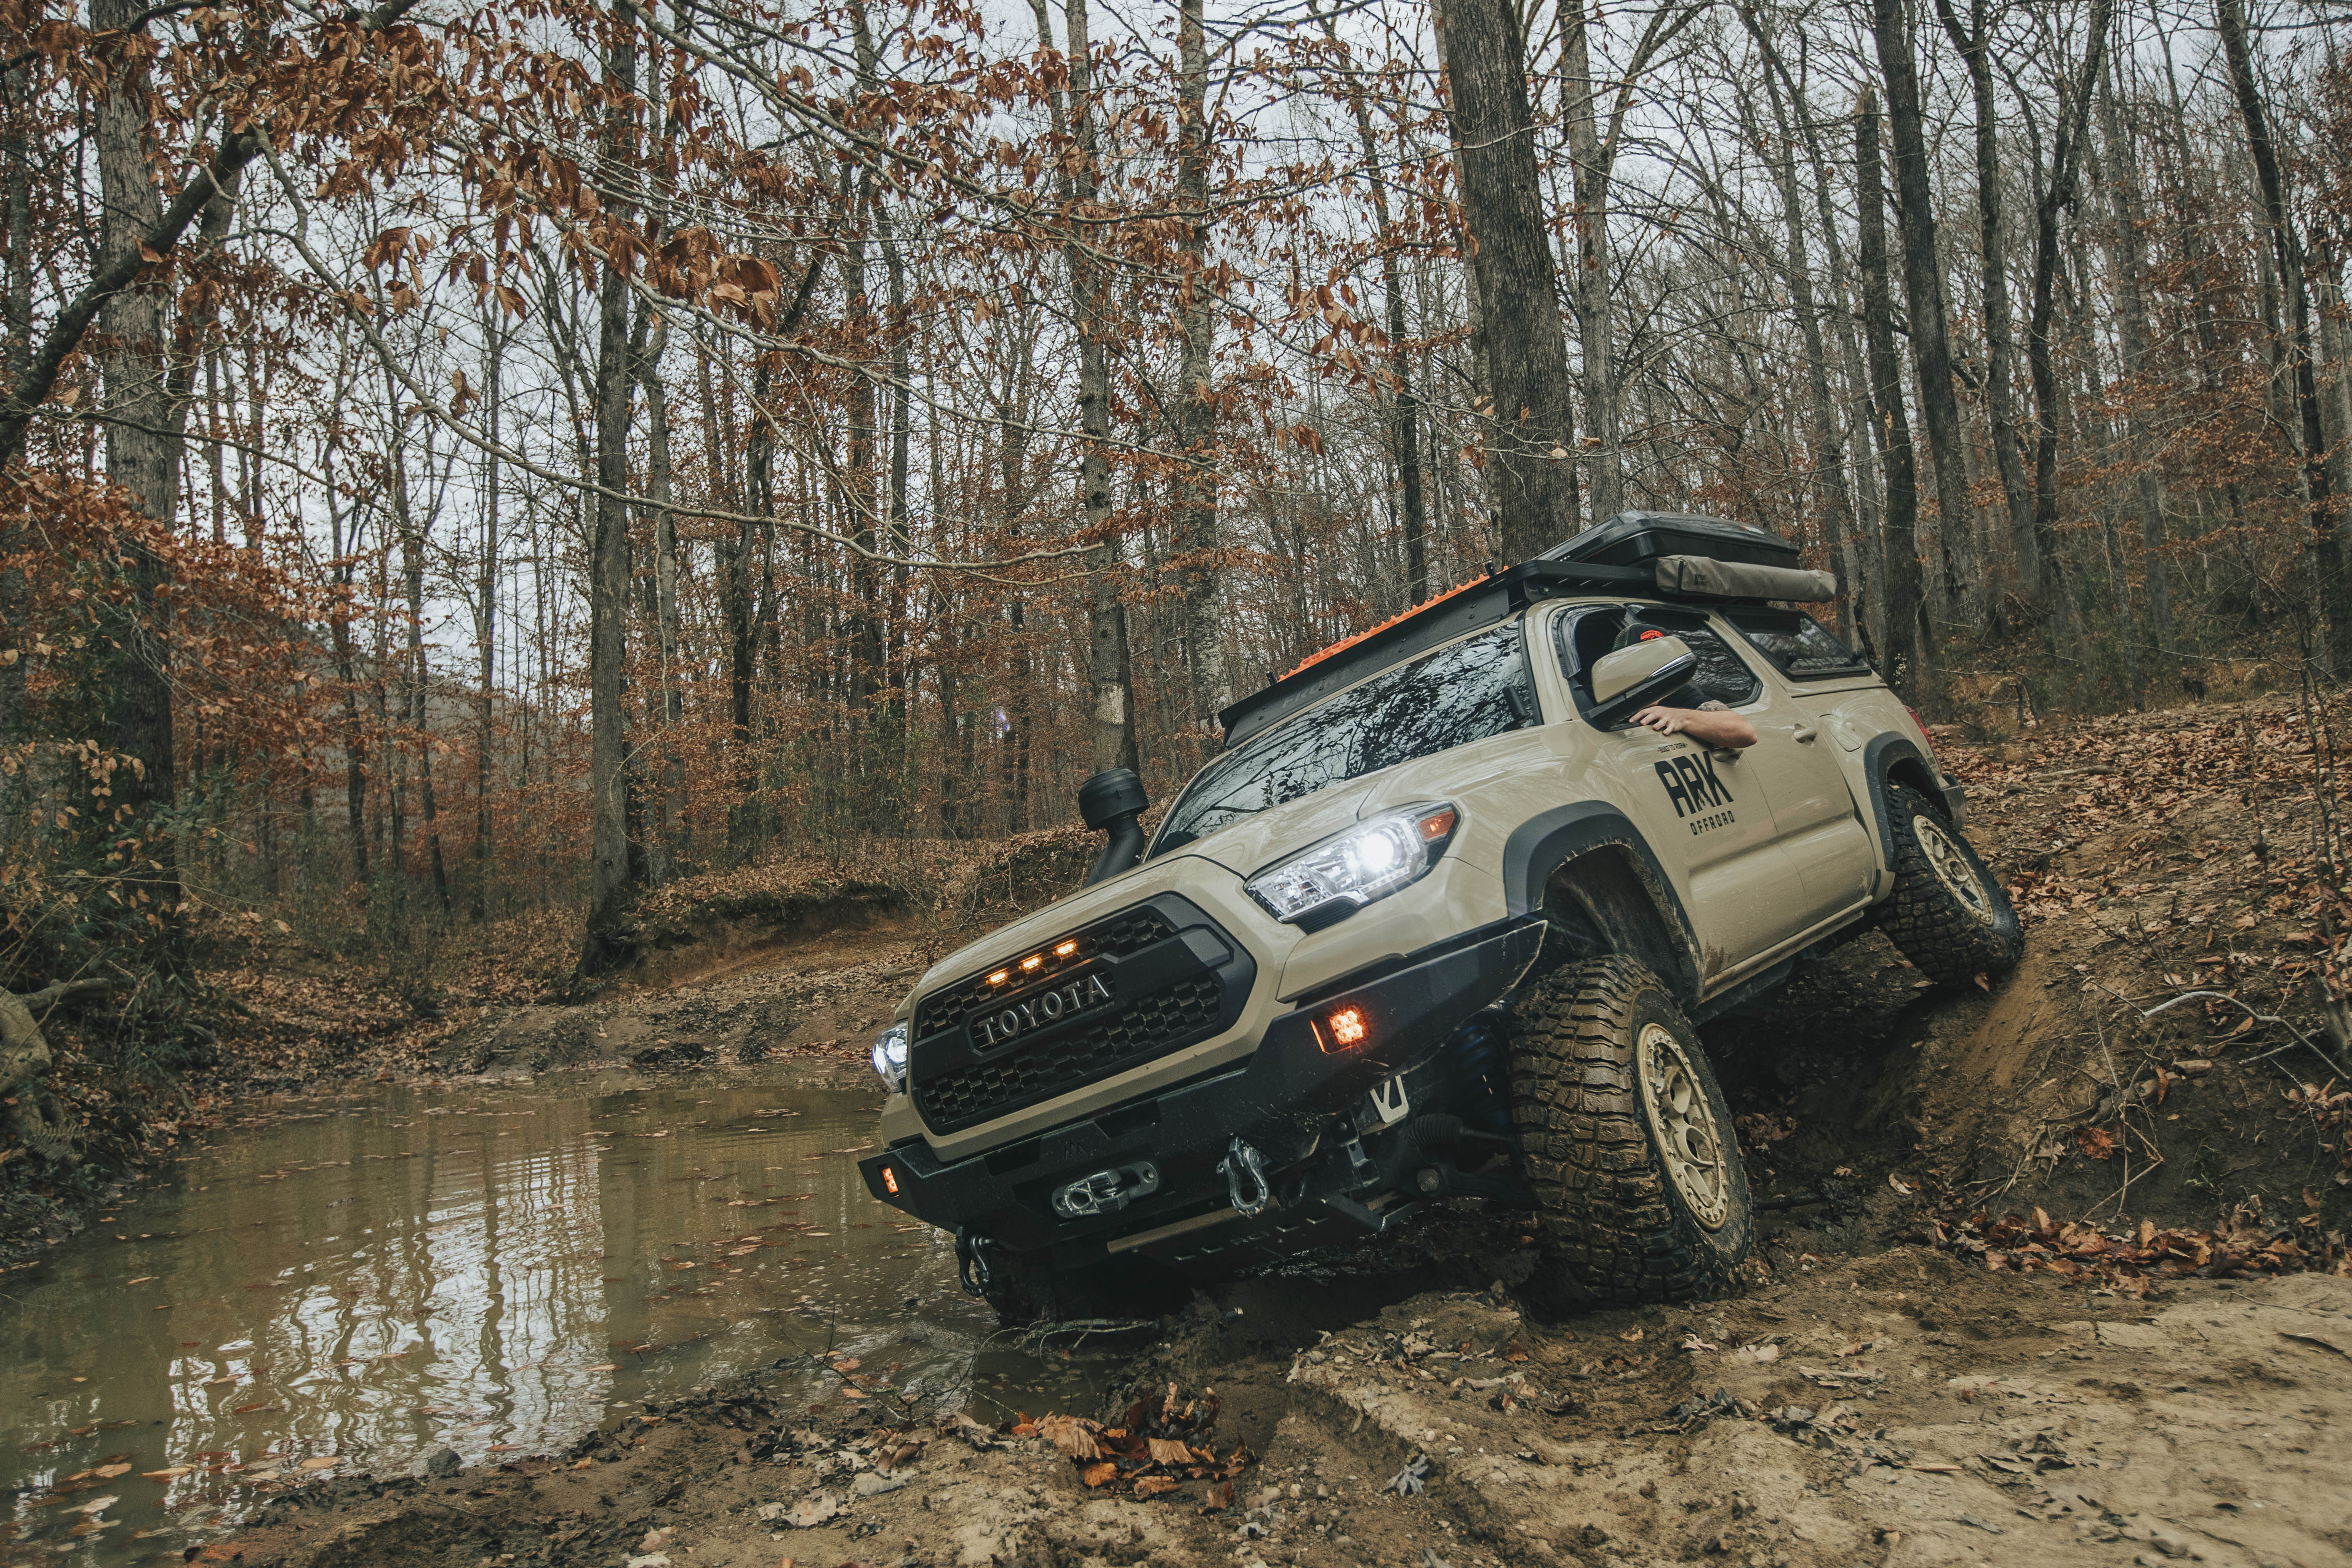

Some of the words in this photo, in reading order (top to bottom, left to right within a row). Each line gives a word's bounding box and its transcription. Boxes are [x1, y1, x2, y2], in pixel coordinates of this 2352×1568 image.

[1654, 751, 1734, 818] ARK
[1690, 810, 1735, 836] OFFROAD
[977, 974, 1114, 1045] TOYOTA
